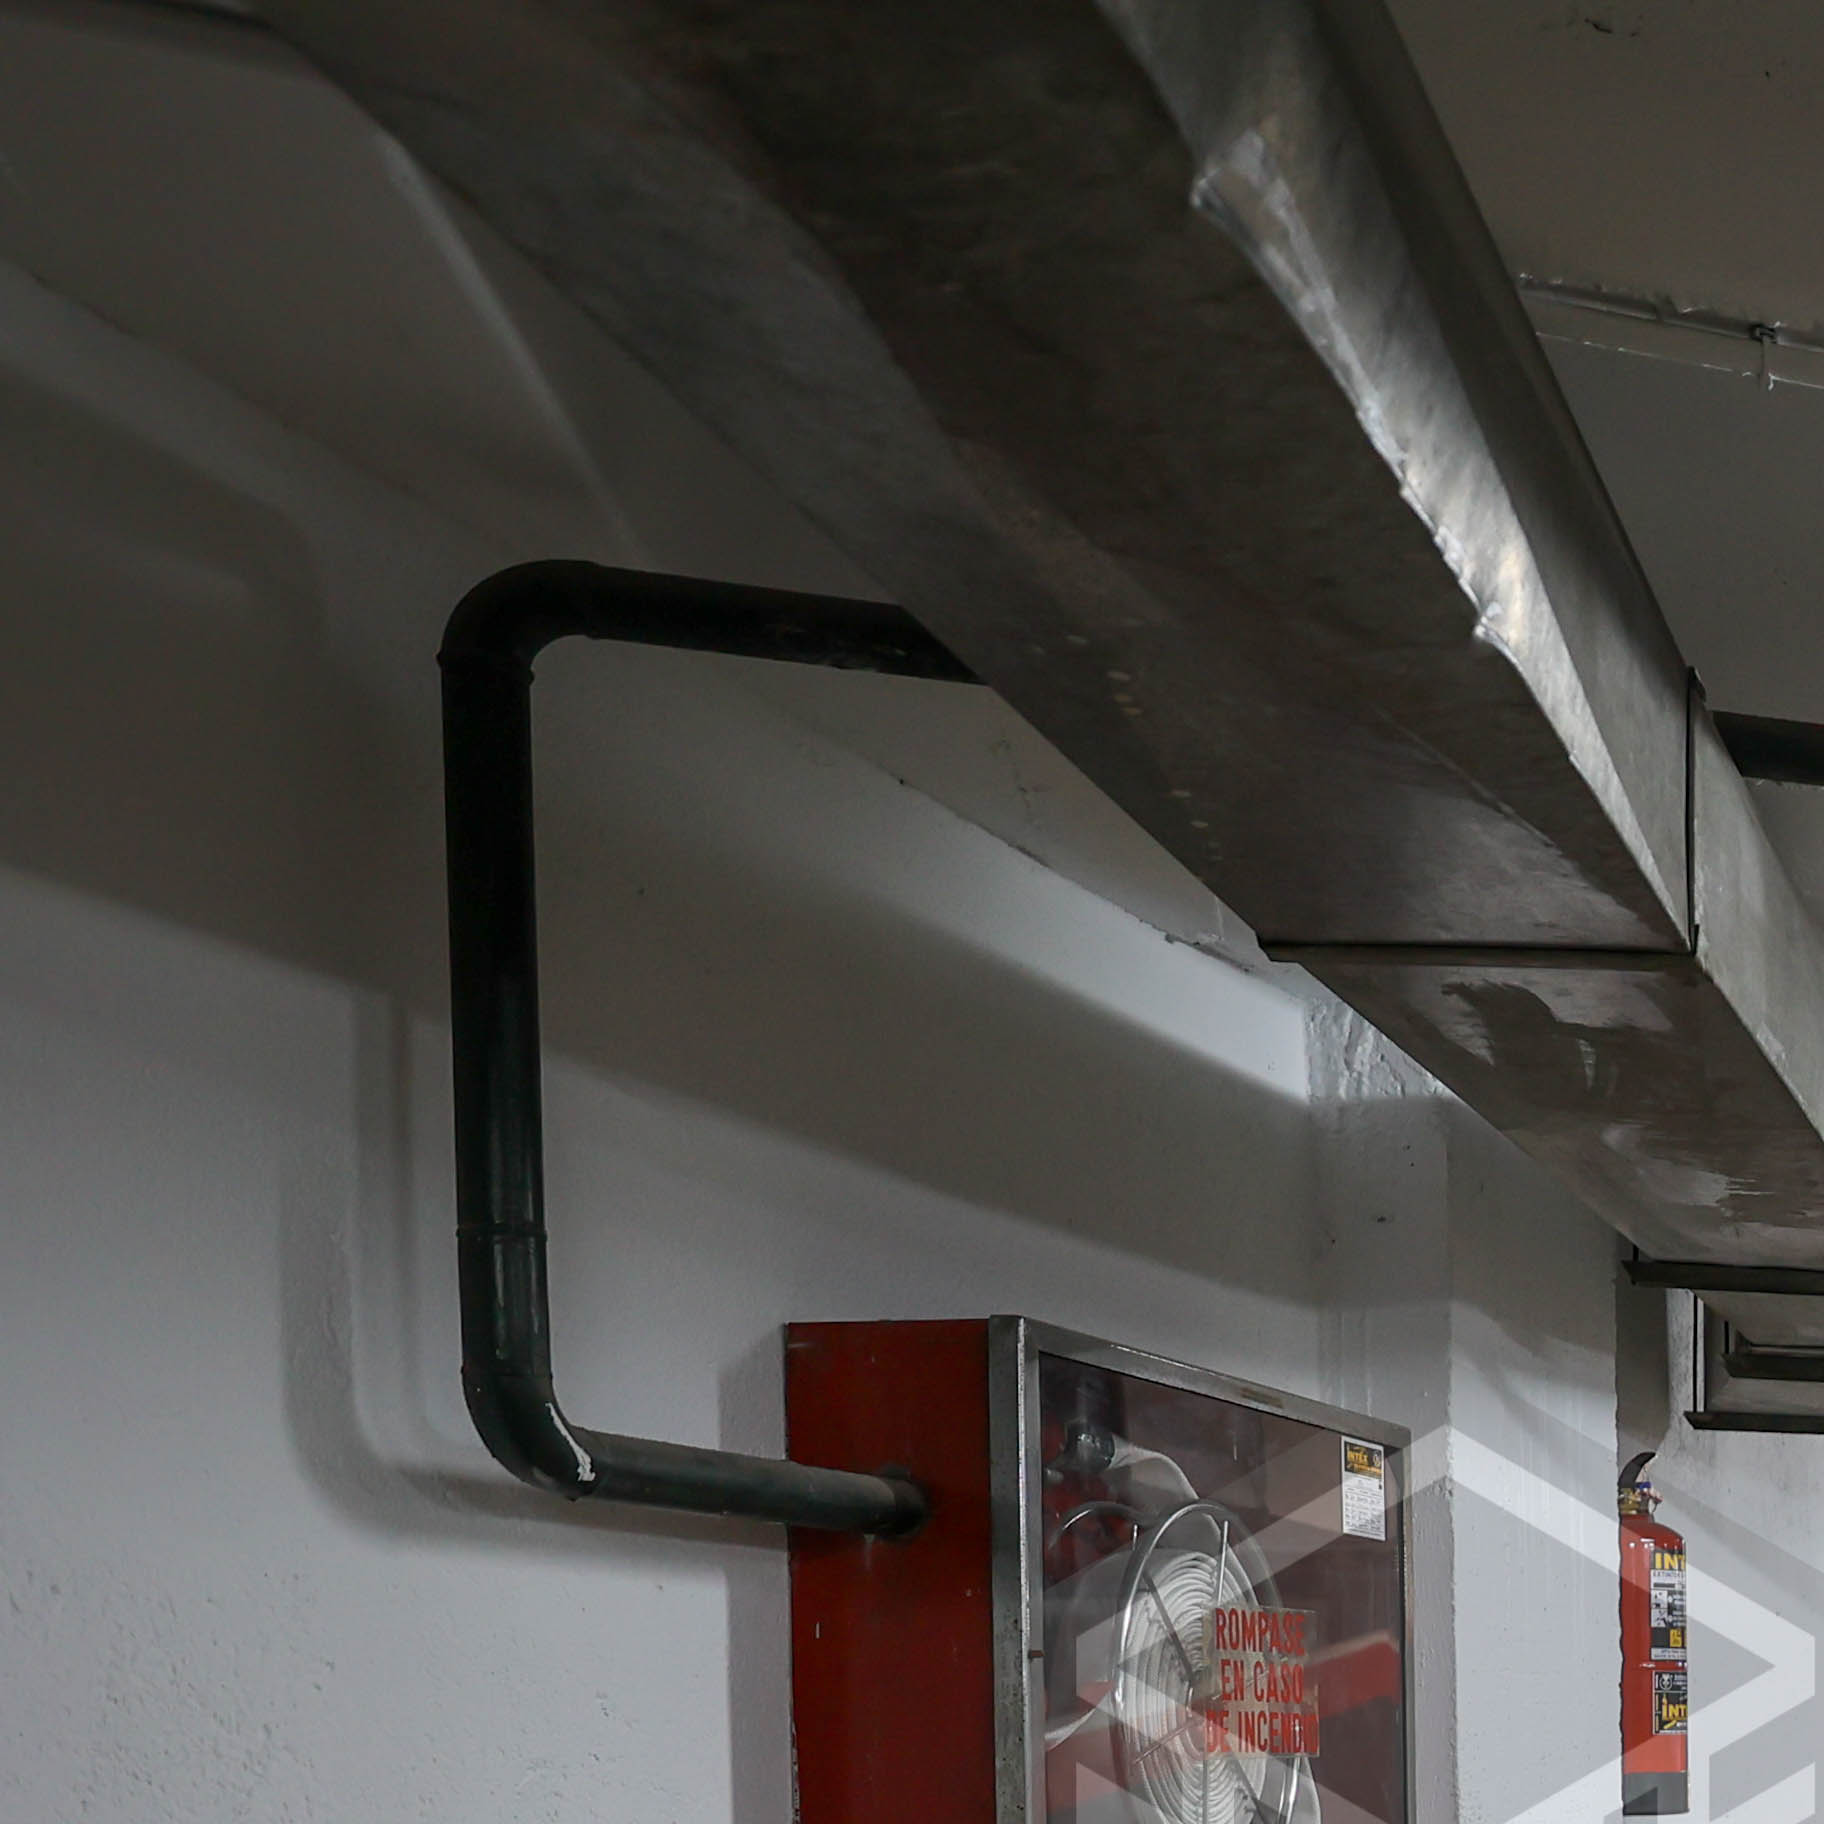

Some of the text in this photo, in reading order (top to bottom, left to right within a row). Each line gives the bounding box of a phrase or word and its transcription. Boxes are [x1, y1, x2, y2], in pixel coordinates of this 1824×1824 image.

[1215, 1607, 1306, 1657] ROMPASE
[1220, 1658, 1305, 1704] EN CASO
[1205, 1708, 1319, 1754] DE INCENDIO
